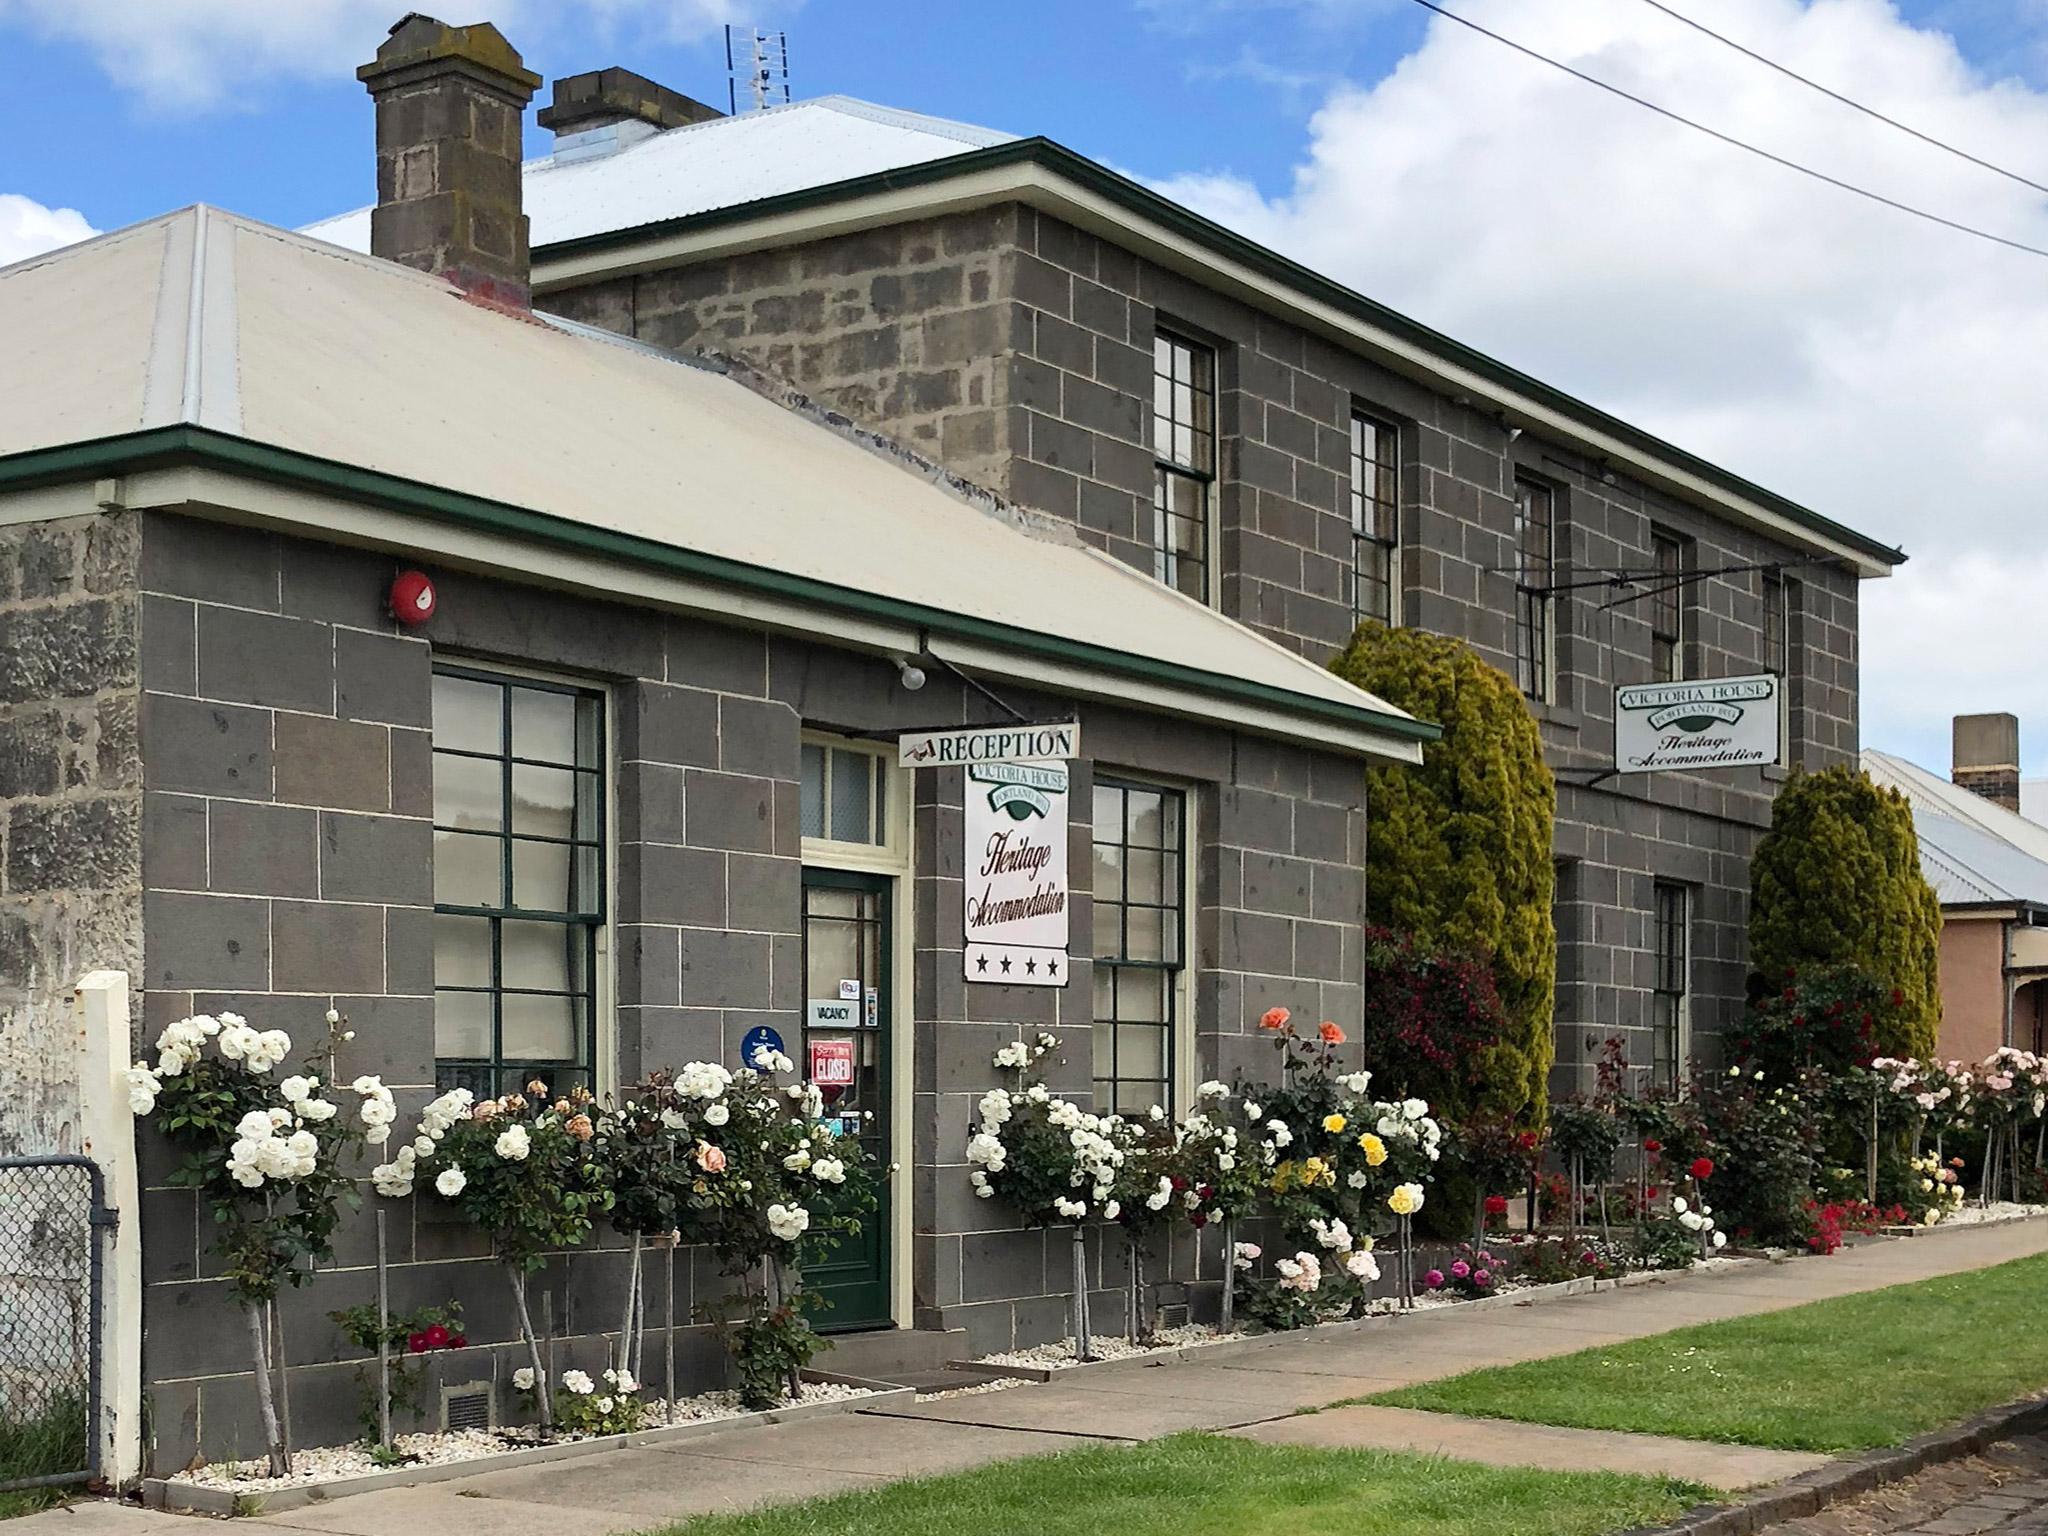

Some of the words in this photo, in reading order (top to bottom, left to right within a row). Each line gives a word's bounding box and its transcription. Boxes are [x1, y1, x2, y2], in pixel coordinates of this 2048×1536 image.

[1627, 688, 1705, 706] VICTORIA
[1711, 683, 1765, 699] HOUSE
[1654, 702, 1716, 724] PORTLAND
[938, 729, 1073, 762] RECEPTION
[1657, 734, 1732, 751] Heritage
[1628, 749, 1763, 768] Accommodation
[976, 763, 1028, 783] VICTORIA
[1031, 770, 1066, 788] HOUSE
[980, 829, 1052, 882] Heritage
[967, 881, 1065, 929] Accommodation
[817, 1007, 850, 1020] VACANCY
[816, 1058, 851, 1080] CLOSED
